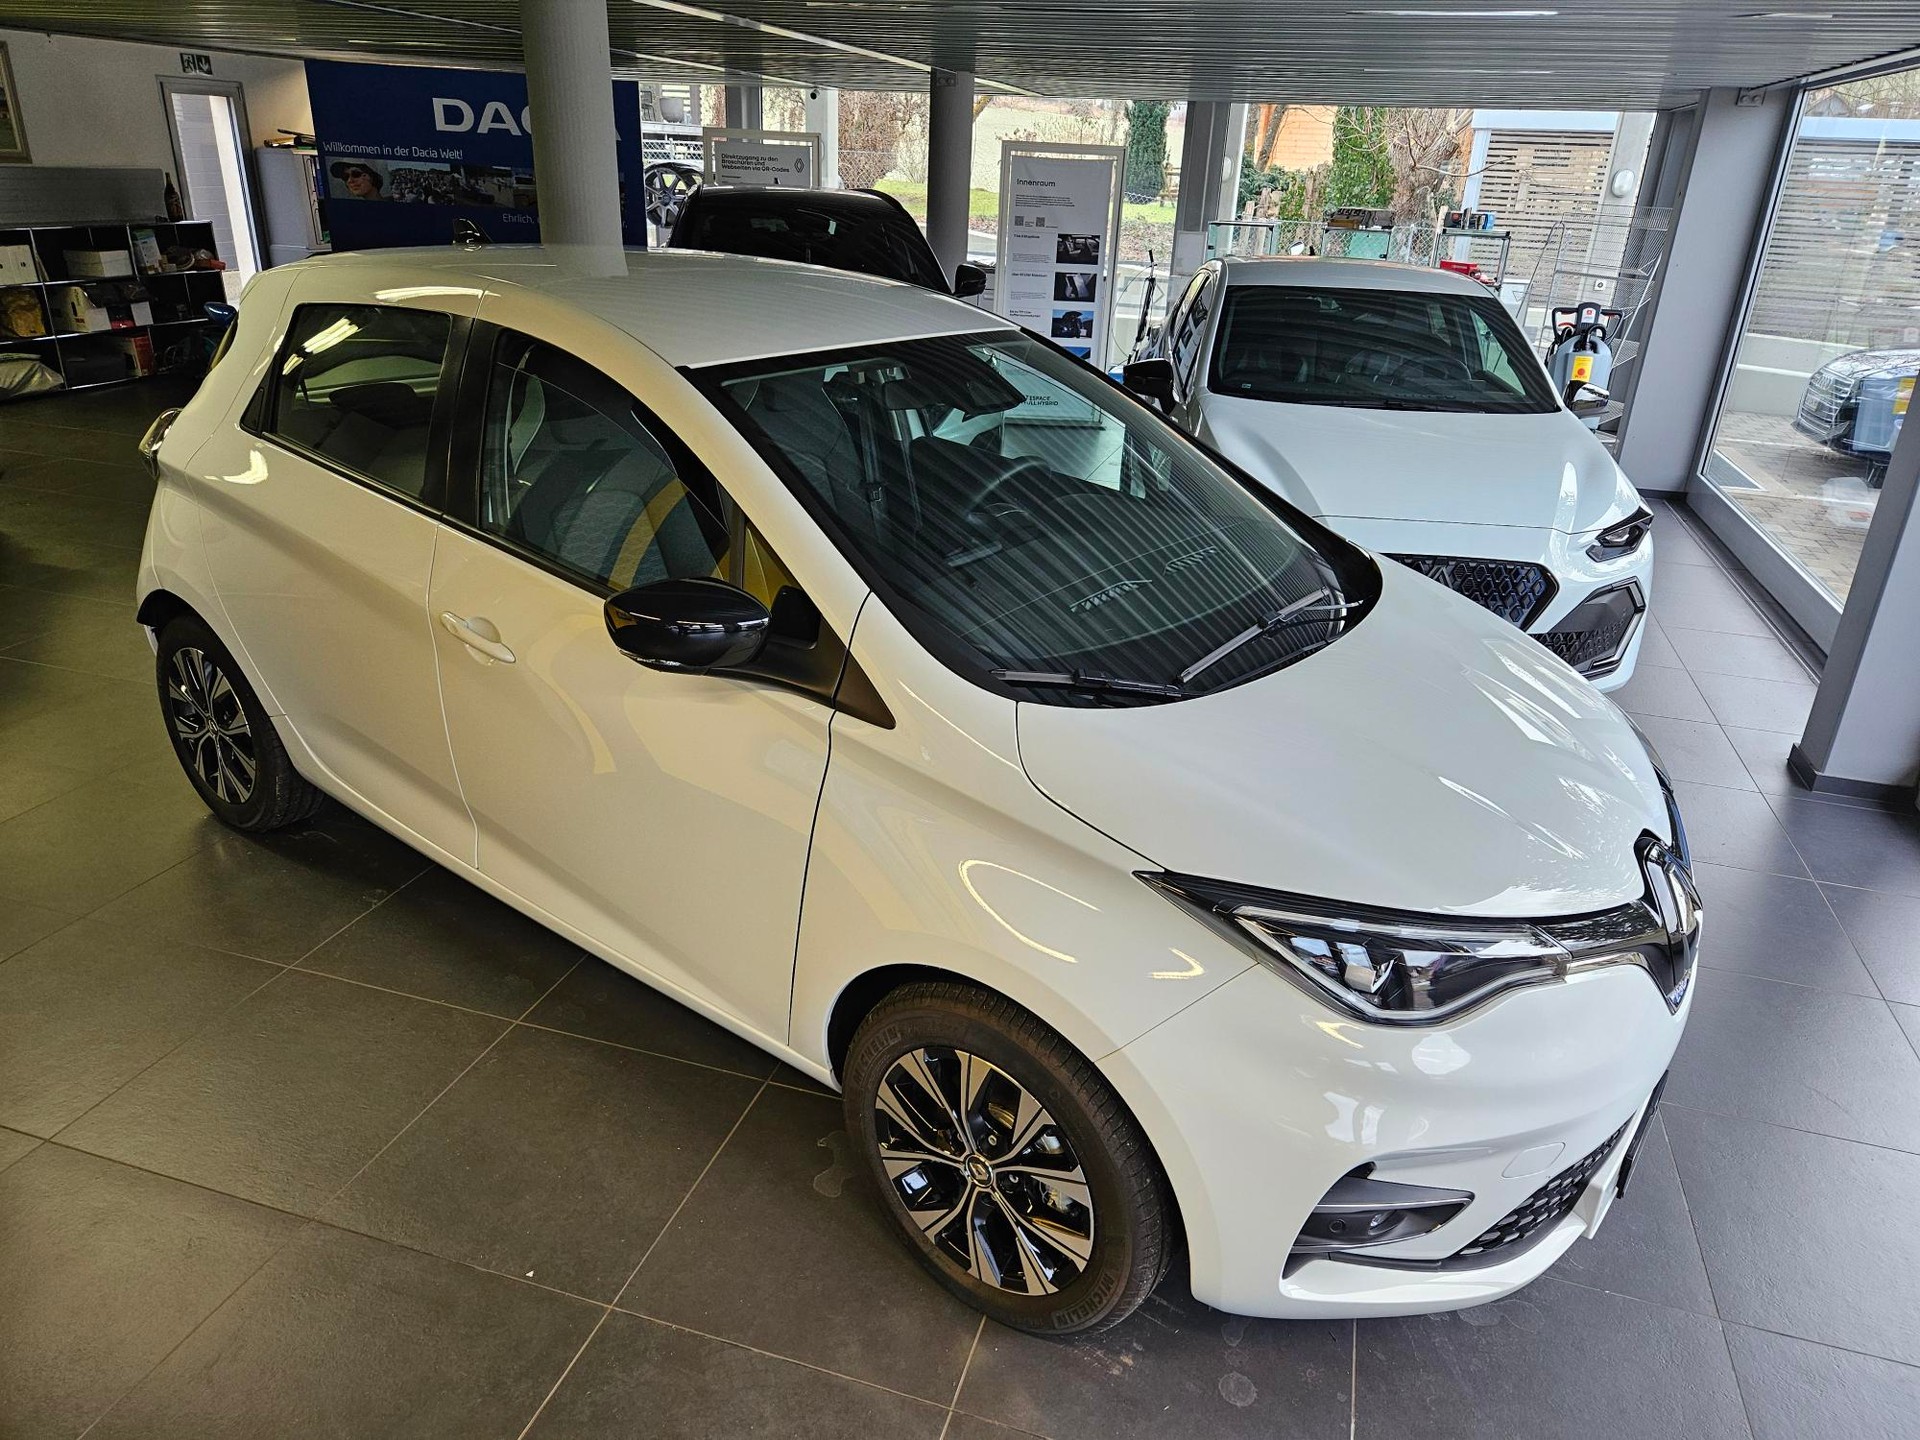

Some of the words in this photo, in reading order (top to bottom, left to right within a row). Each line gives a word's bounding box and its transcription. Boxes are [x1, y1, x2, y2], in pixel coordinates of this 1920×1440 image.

[322, 141, 380, 154] Willkommen
[383, 145, 392, 155] in
[394, 146, 409, 156] der
[412, 146, 438, 158] Dacia
[440, 149, 463, 159] Welt!
[721, 153, 760, 162] Direktzugang
[1016, 178, 1056, 187] Innenraum
[502, 213, 535, 224] Ehrlich,
[852, 1025, 901, 1083] MICHELIN
[1055, 1272, 1115, 1328] MICHELIN
